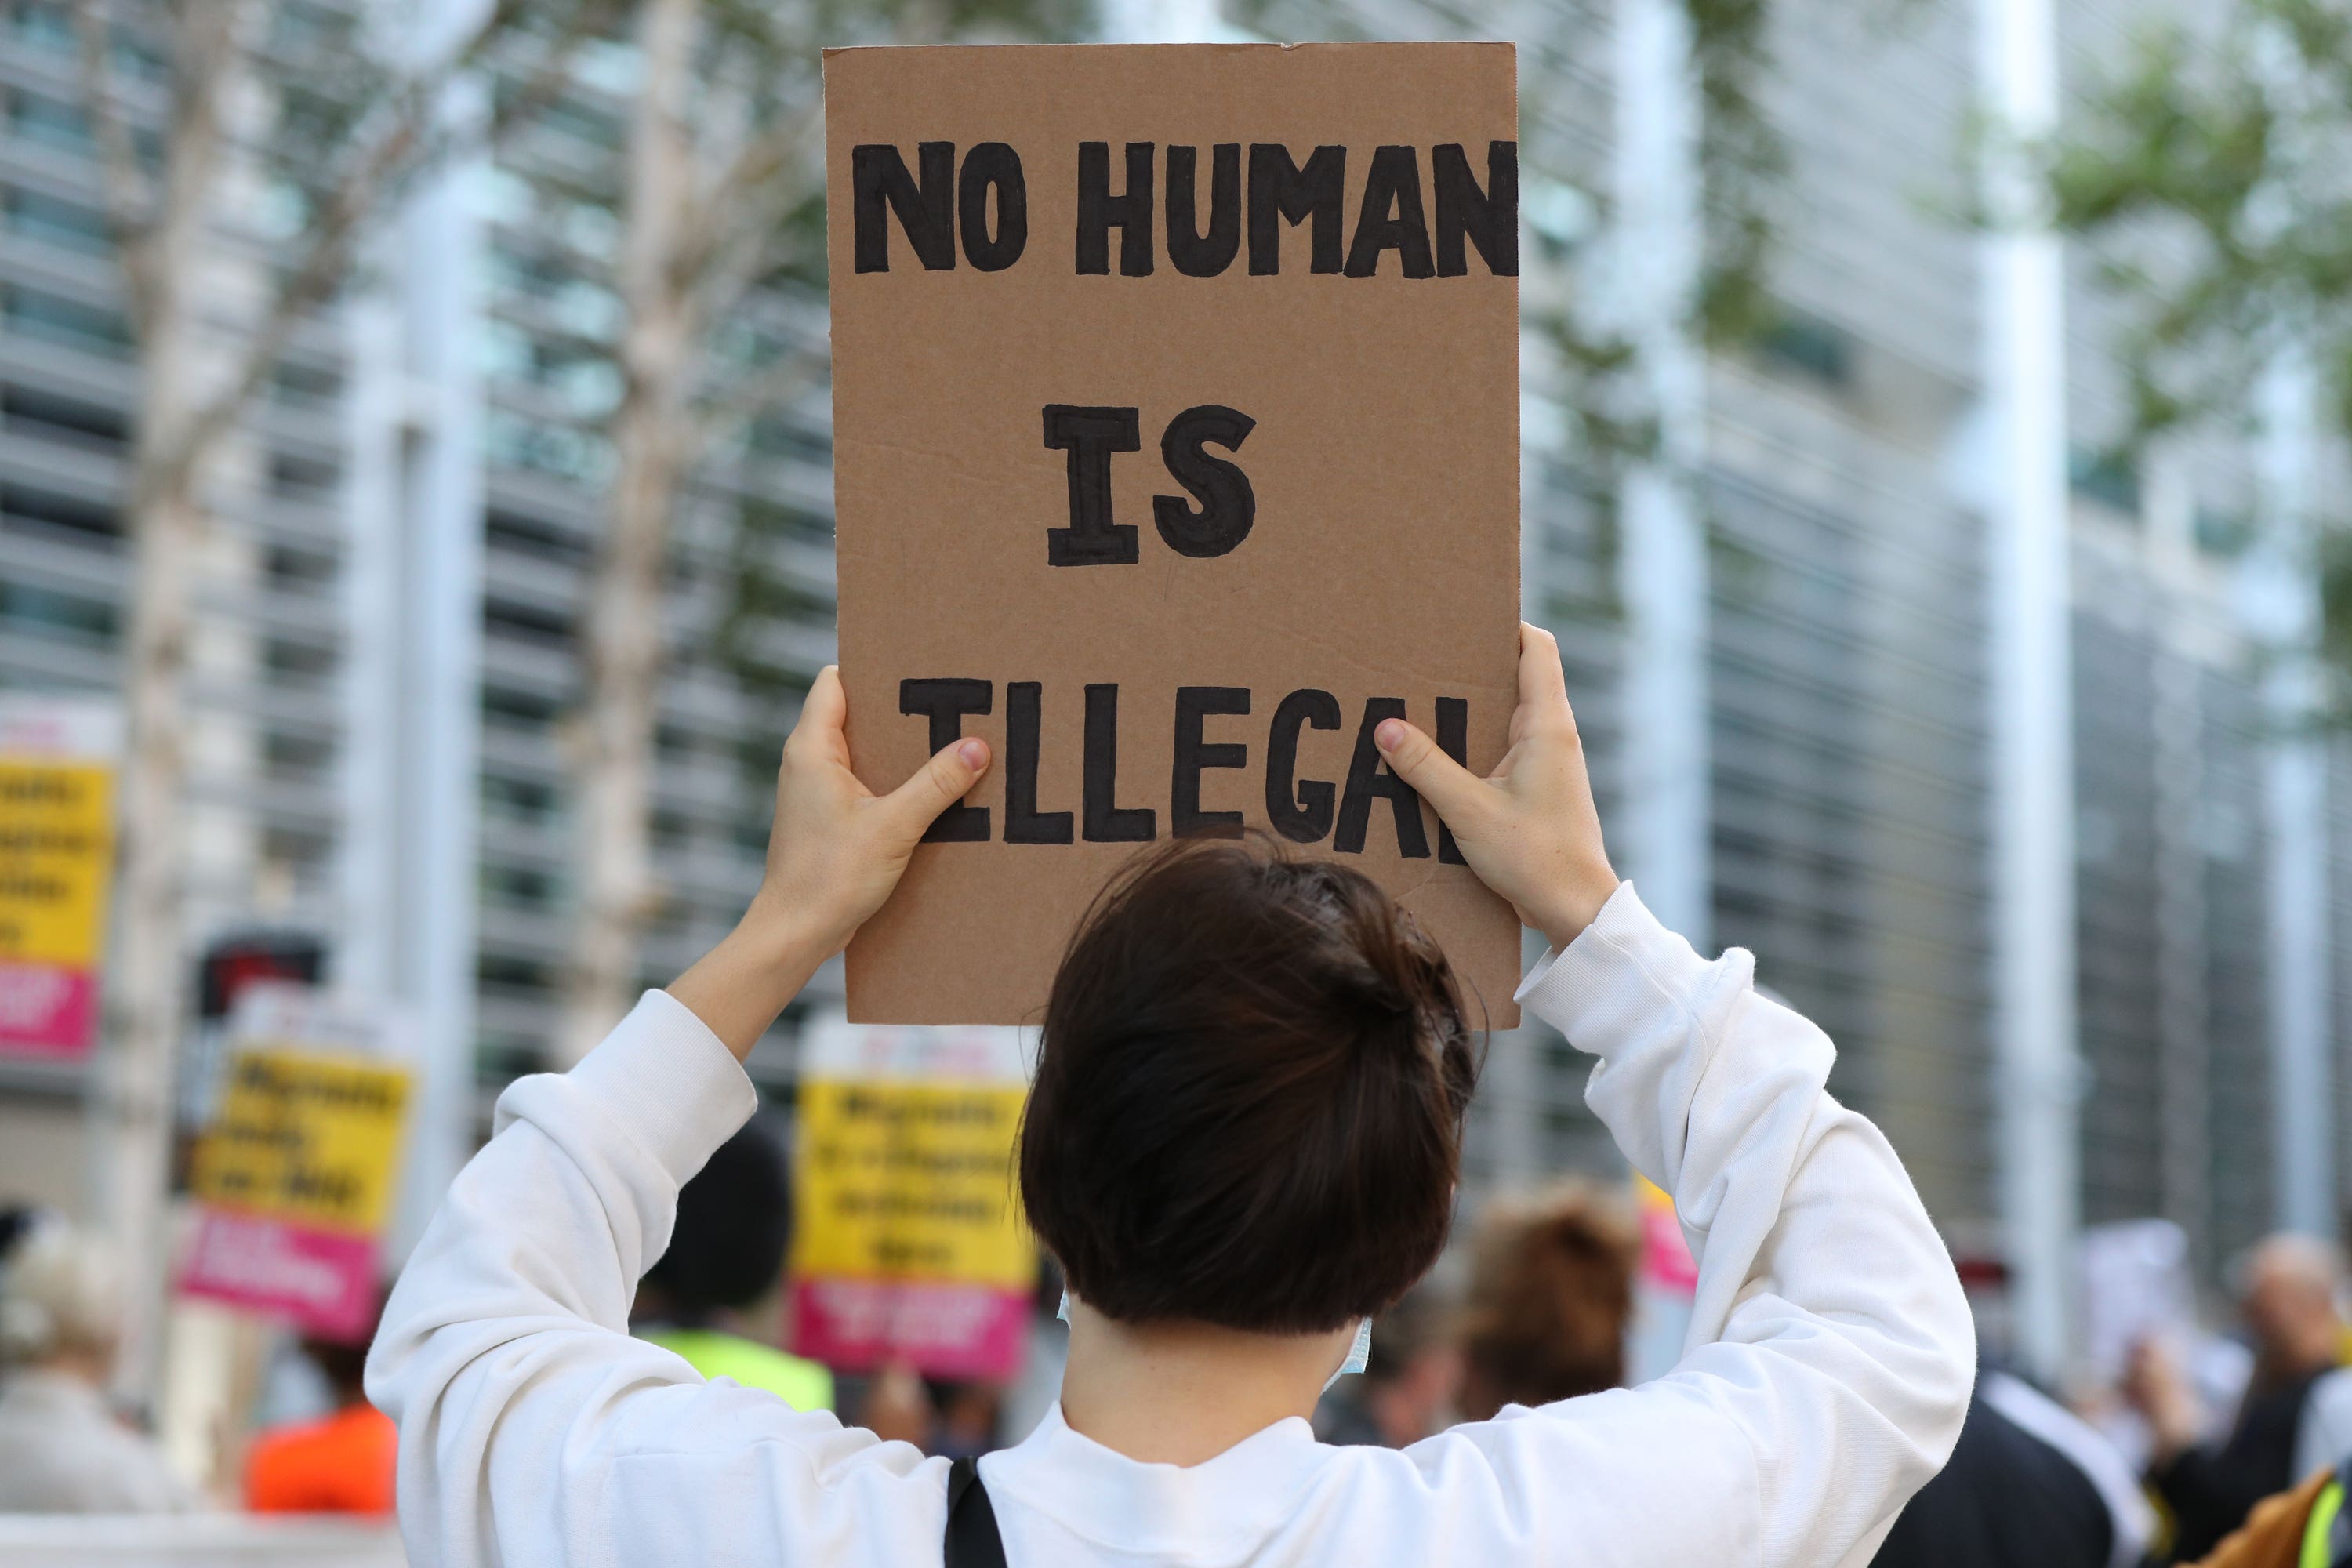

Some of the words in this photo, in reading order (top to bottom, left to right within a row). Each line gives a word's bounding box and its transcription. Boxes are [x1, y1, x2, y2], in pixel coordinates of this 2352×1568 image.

[852, 141, 1028, 274] NO
[1076, 140, 1519, 279] HUMAN
[1042, 404, 1257, 567] IS
